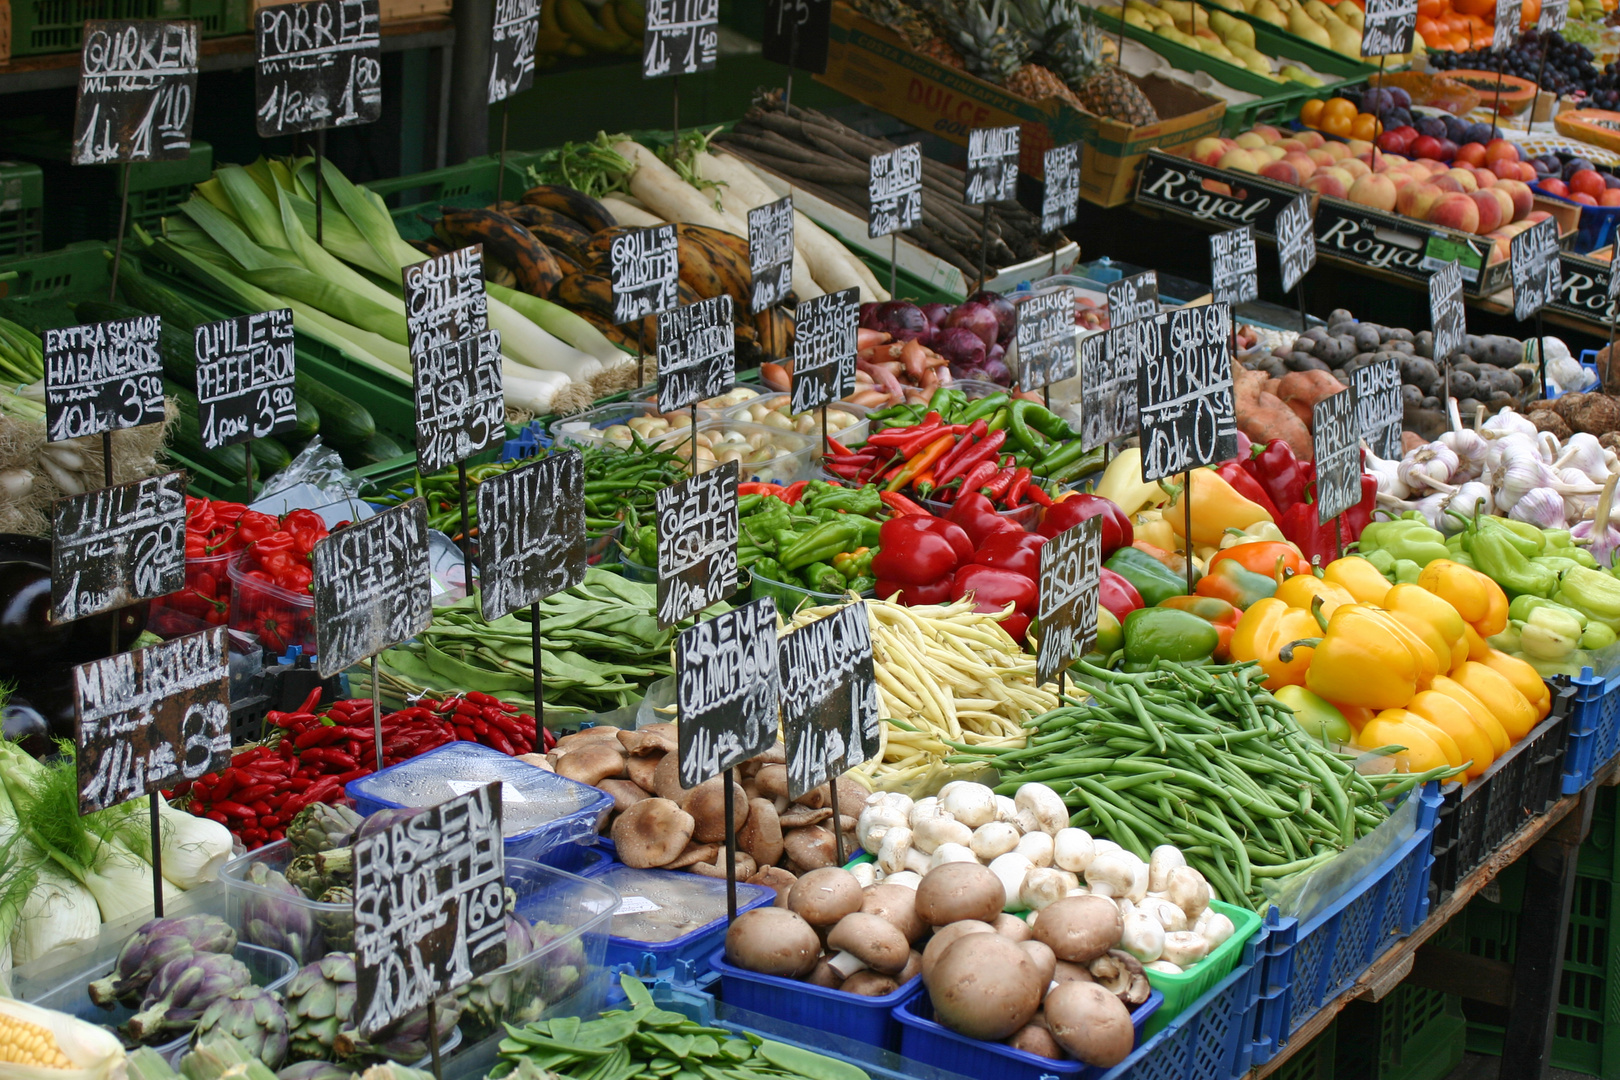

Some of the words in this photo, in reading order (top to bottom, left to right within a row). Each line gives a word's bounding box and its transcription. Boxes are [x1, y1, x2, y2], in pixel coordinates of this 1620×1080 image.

[83, 24, 198, 76] GURKEN
[261, 0, 379, 57] PORREE
[906, 77, 990, 124] DULCE
[934, 117, 973, 138] GOL
[1142, 167, 1271, 224] Royal
[612, 230, 661, 265] GRILL
[45, 322, 106, 354] EXTRA
[196, 315, 268, 363] CHILE
[794, 300, 861, 342] SCHARFE
[1137, 313, 1168, 368] ROT
[1170, 308, 1204, 352] GELB
[46, 341, 163, 386] HABANEROS
[1147, 340, 1232, 406] PAPRIKA
[1315, 388, 1352, 433] DOLMA
[1315, 406, 1361, 464] PAPRIKA
[660, 475, 736, 541] GELBE
[314, 508, 420, 588] AUSTERN
[658, 507, 738, 575] FISOLEN
[334, 552, 397, 613] PILZE
[1039, 535, 1101, 615] FISOLEN
[354, 785, 492, 890] ERBSEN
